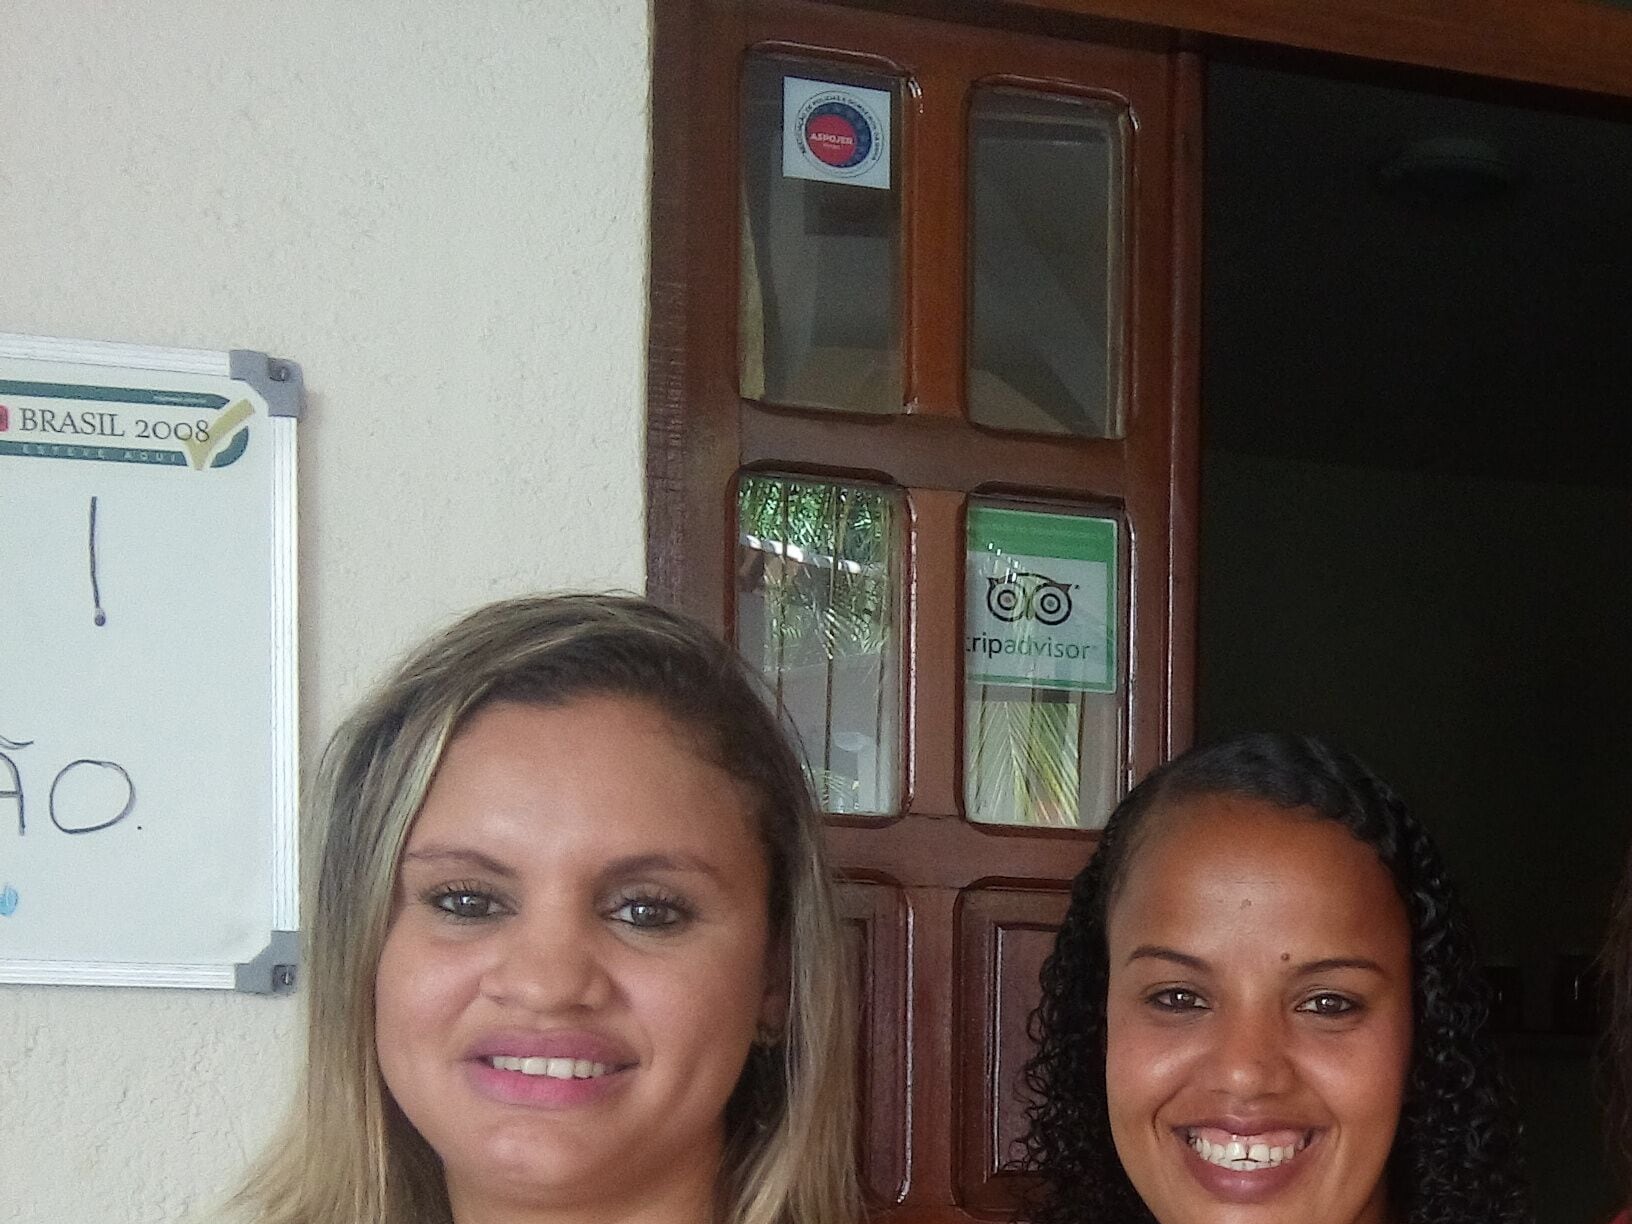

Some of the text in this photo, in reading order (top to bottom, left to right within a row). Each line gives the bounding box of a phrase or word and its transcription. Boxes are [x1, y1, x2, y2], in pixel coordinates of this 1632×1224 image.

[19, 407, 211, 442] BRASIL 2008
[123, 451, 177, 463] AQUI
[966, 631, 1091, 660] ripadvisor
